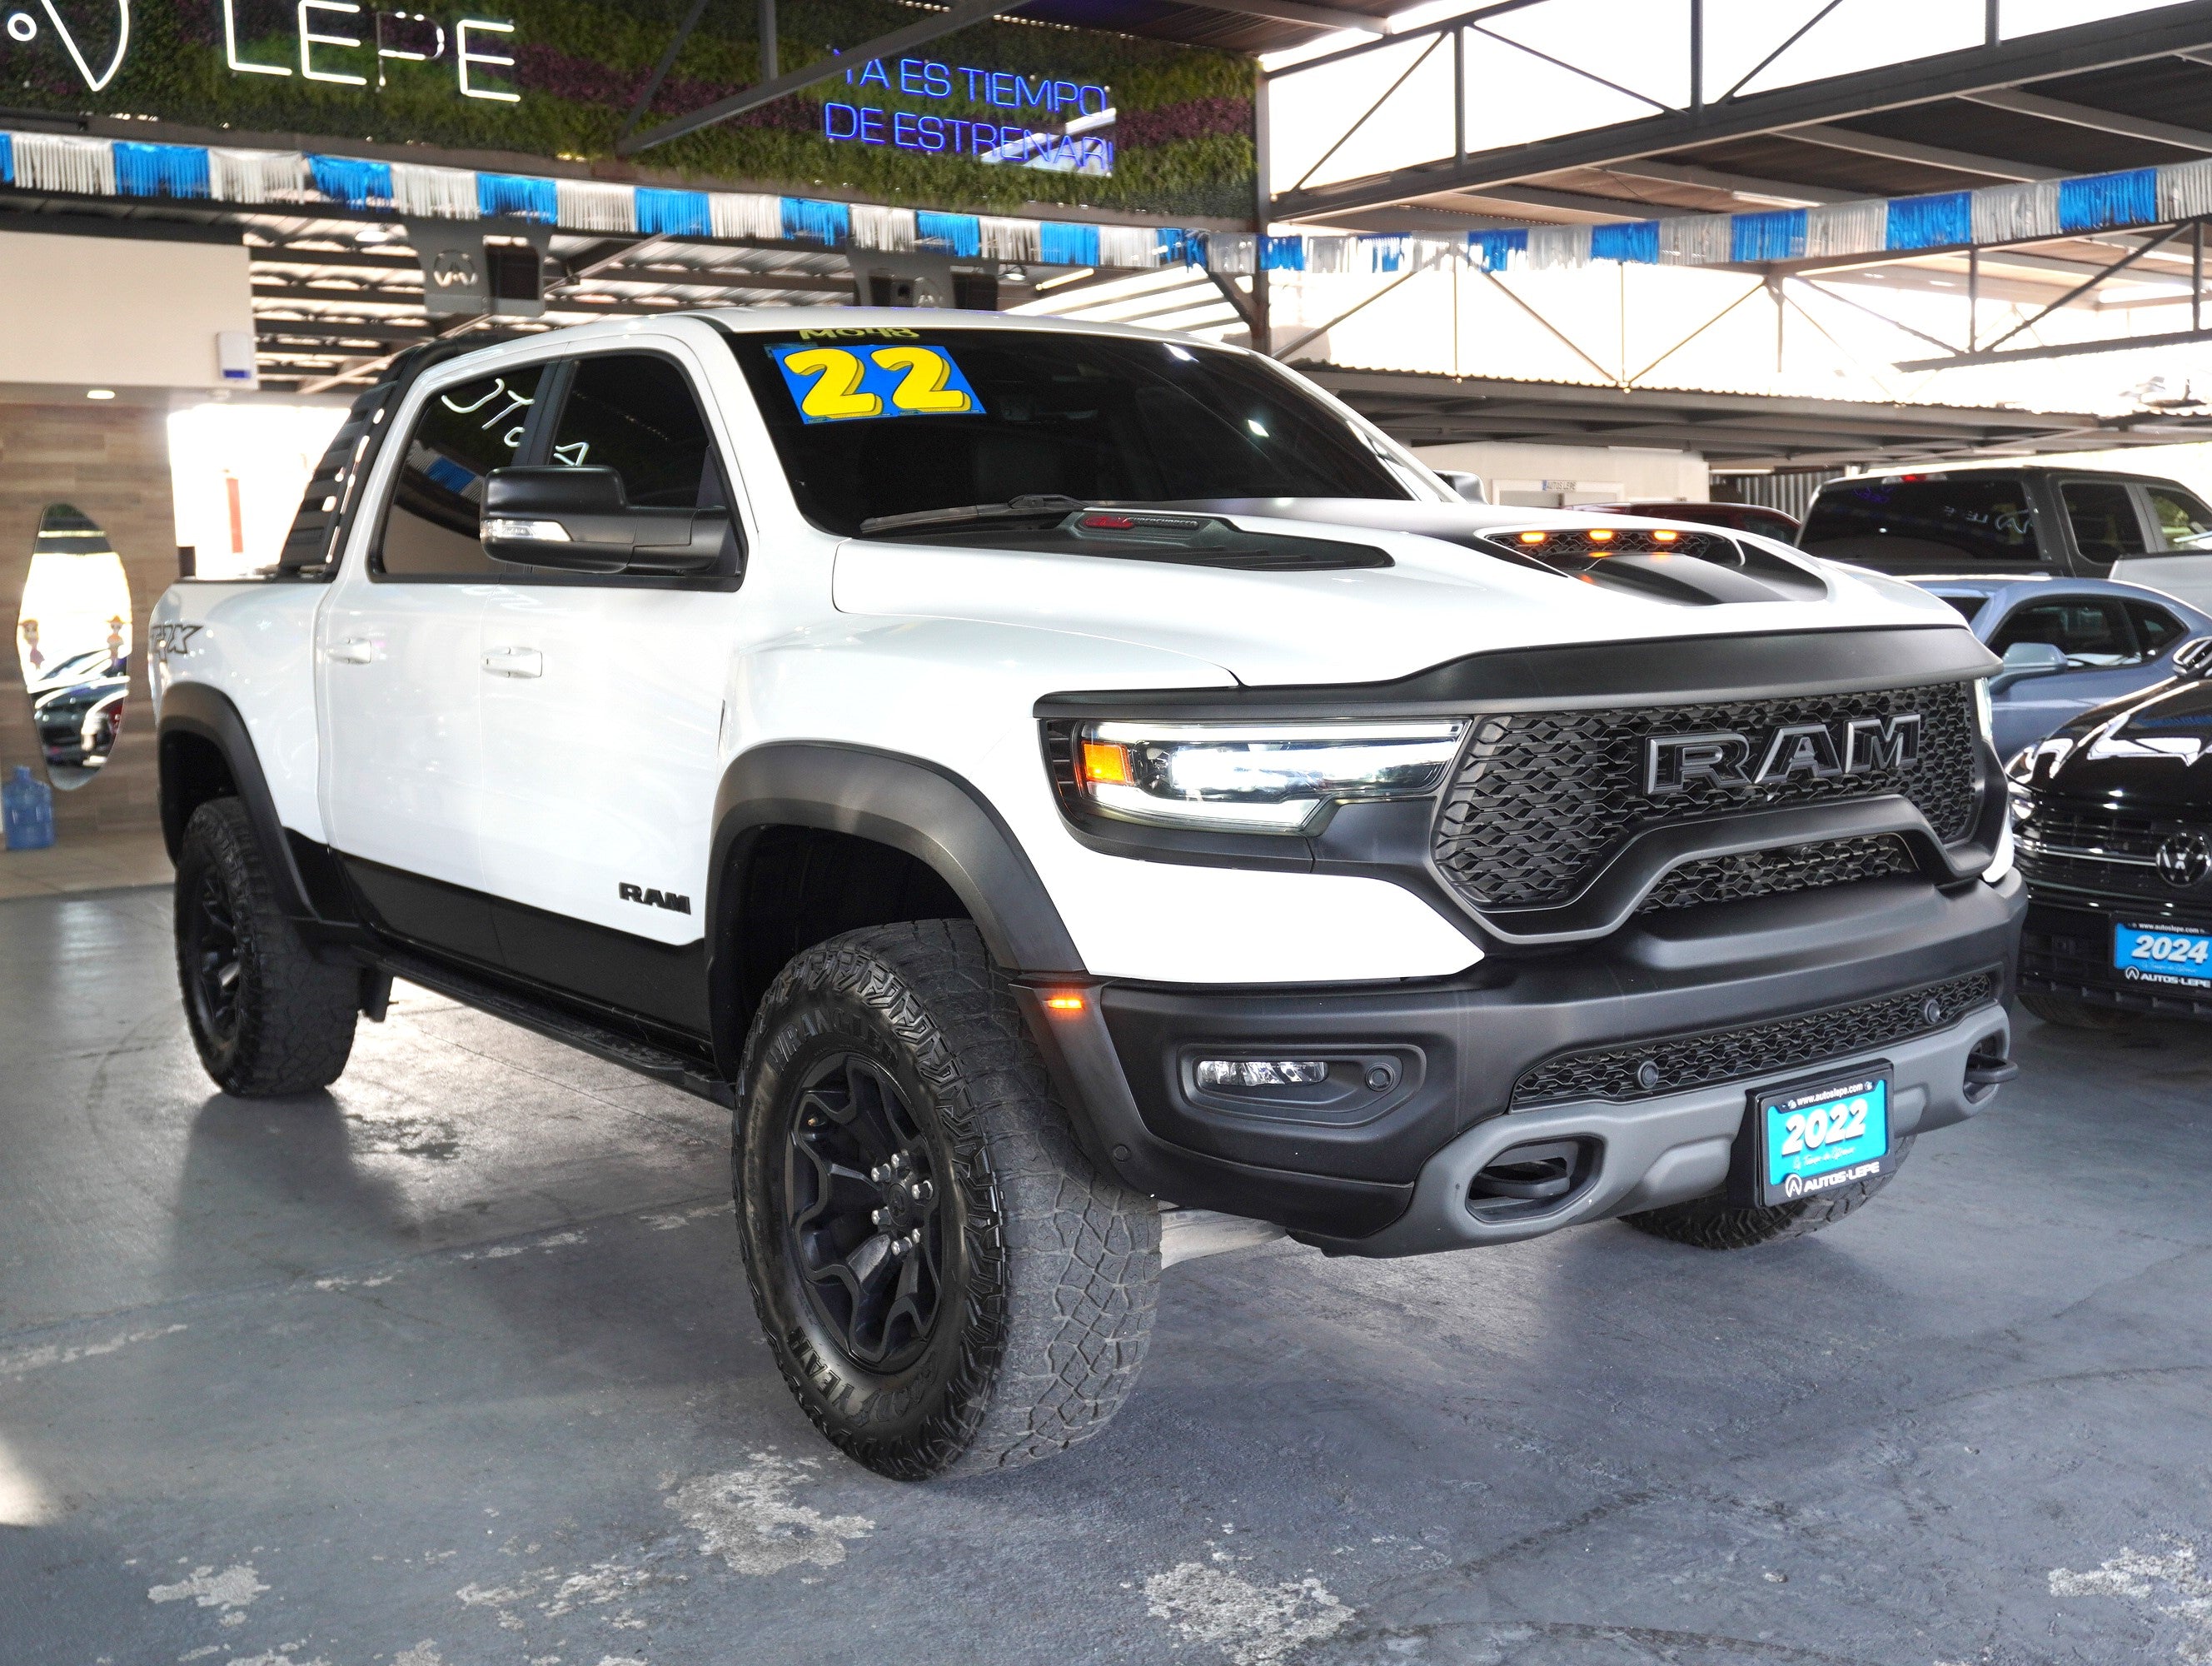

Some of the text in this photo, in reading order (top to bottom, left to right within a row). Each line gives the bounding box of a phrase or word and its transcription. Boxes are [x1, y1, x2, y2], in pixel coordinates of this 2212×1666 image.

[223, 0, 521, 102] LEPE
[899, 57, 952, 99] ES
[957, 66, 1108, 117] TIEMPO
[824, 101, 885, 145] DE
[784, 347, 972, 418] 22
[1643, 713, 1921, 796] RAM
[618, 881, 691, 915] RAM
[2131, 934, 2210, 965] 2024
[1781, 1098, 1869, 1156] 2022
